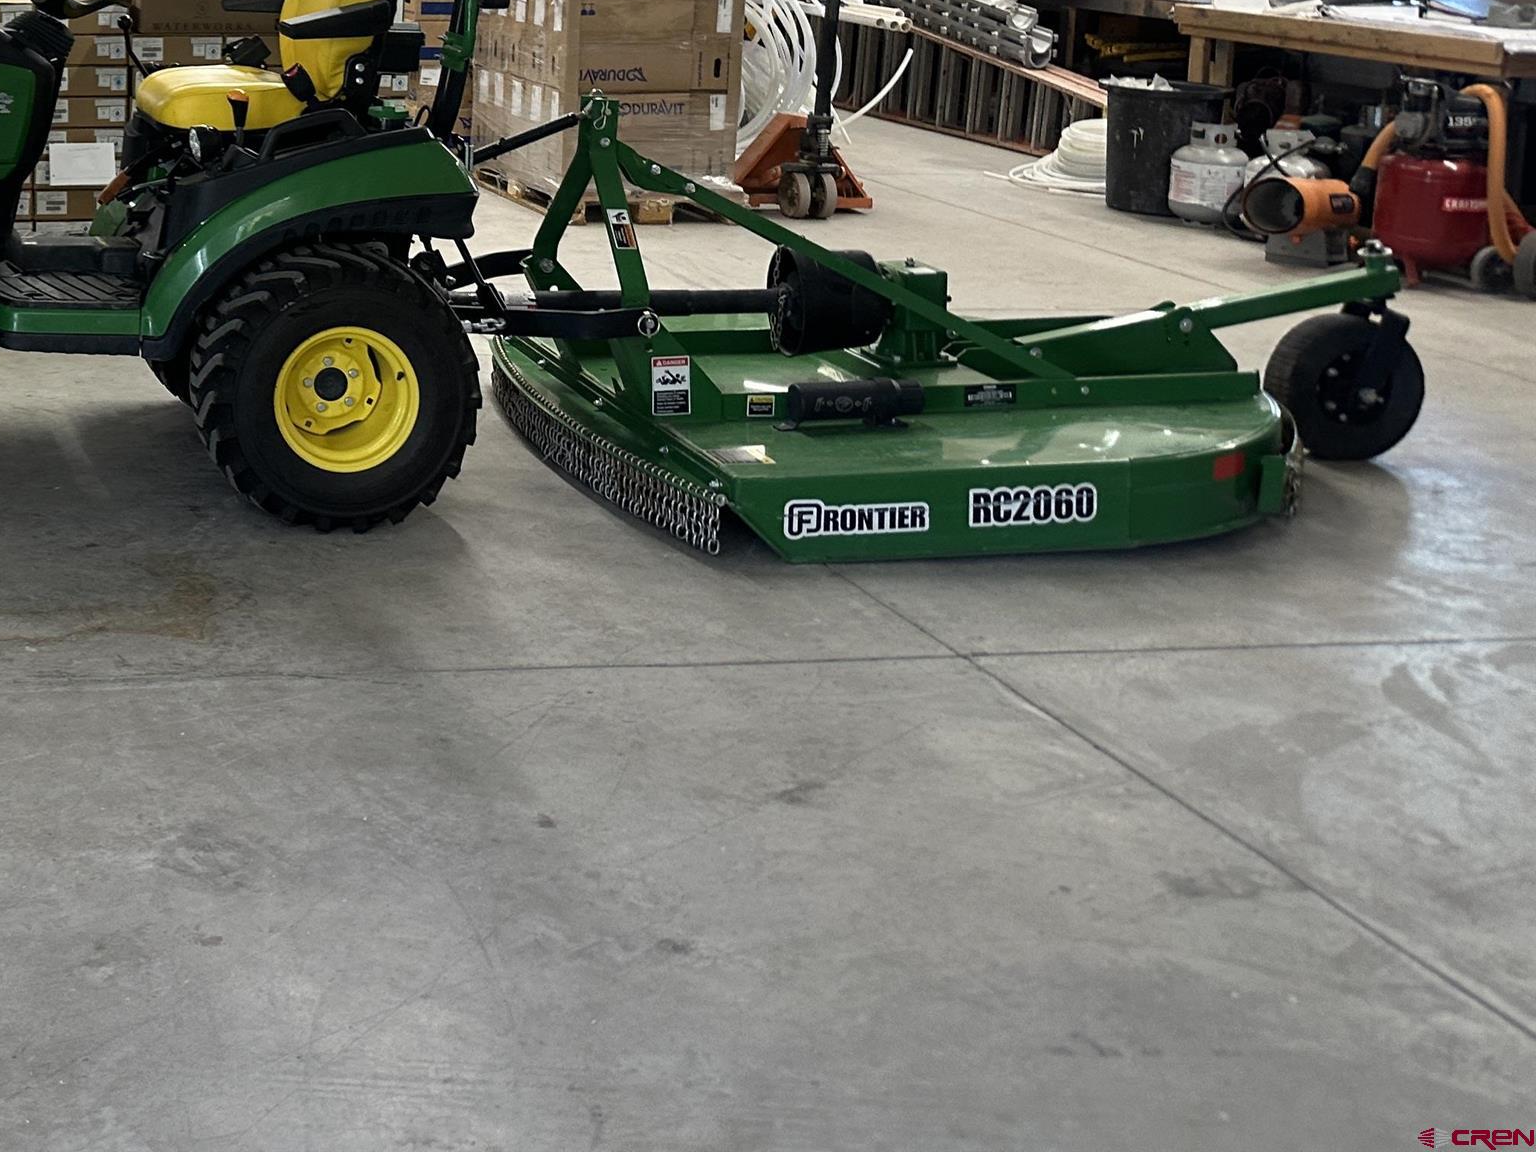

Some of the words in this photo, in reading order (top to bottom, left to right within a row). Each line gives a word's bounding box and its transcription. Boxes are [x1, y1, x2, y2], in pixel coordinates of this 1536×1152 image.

[579, 67, 625, 85] DURAVI
[632, 99, 686, 116] DURAVIT
[788, 503, 927, 536] FRONTIER
[972, 486, 1095, 524] RC2060
